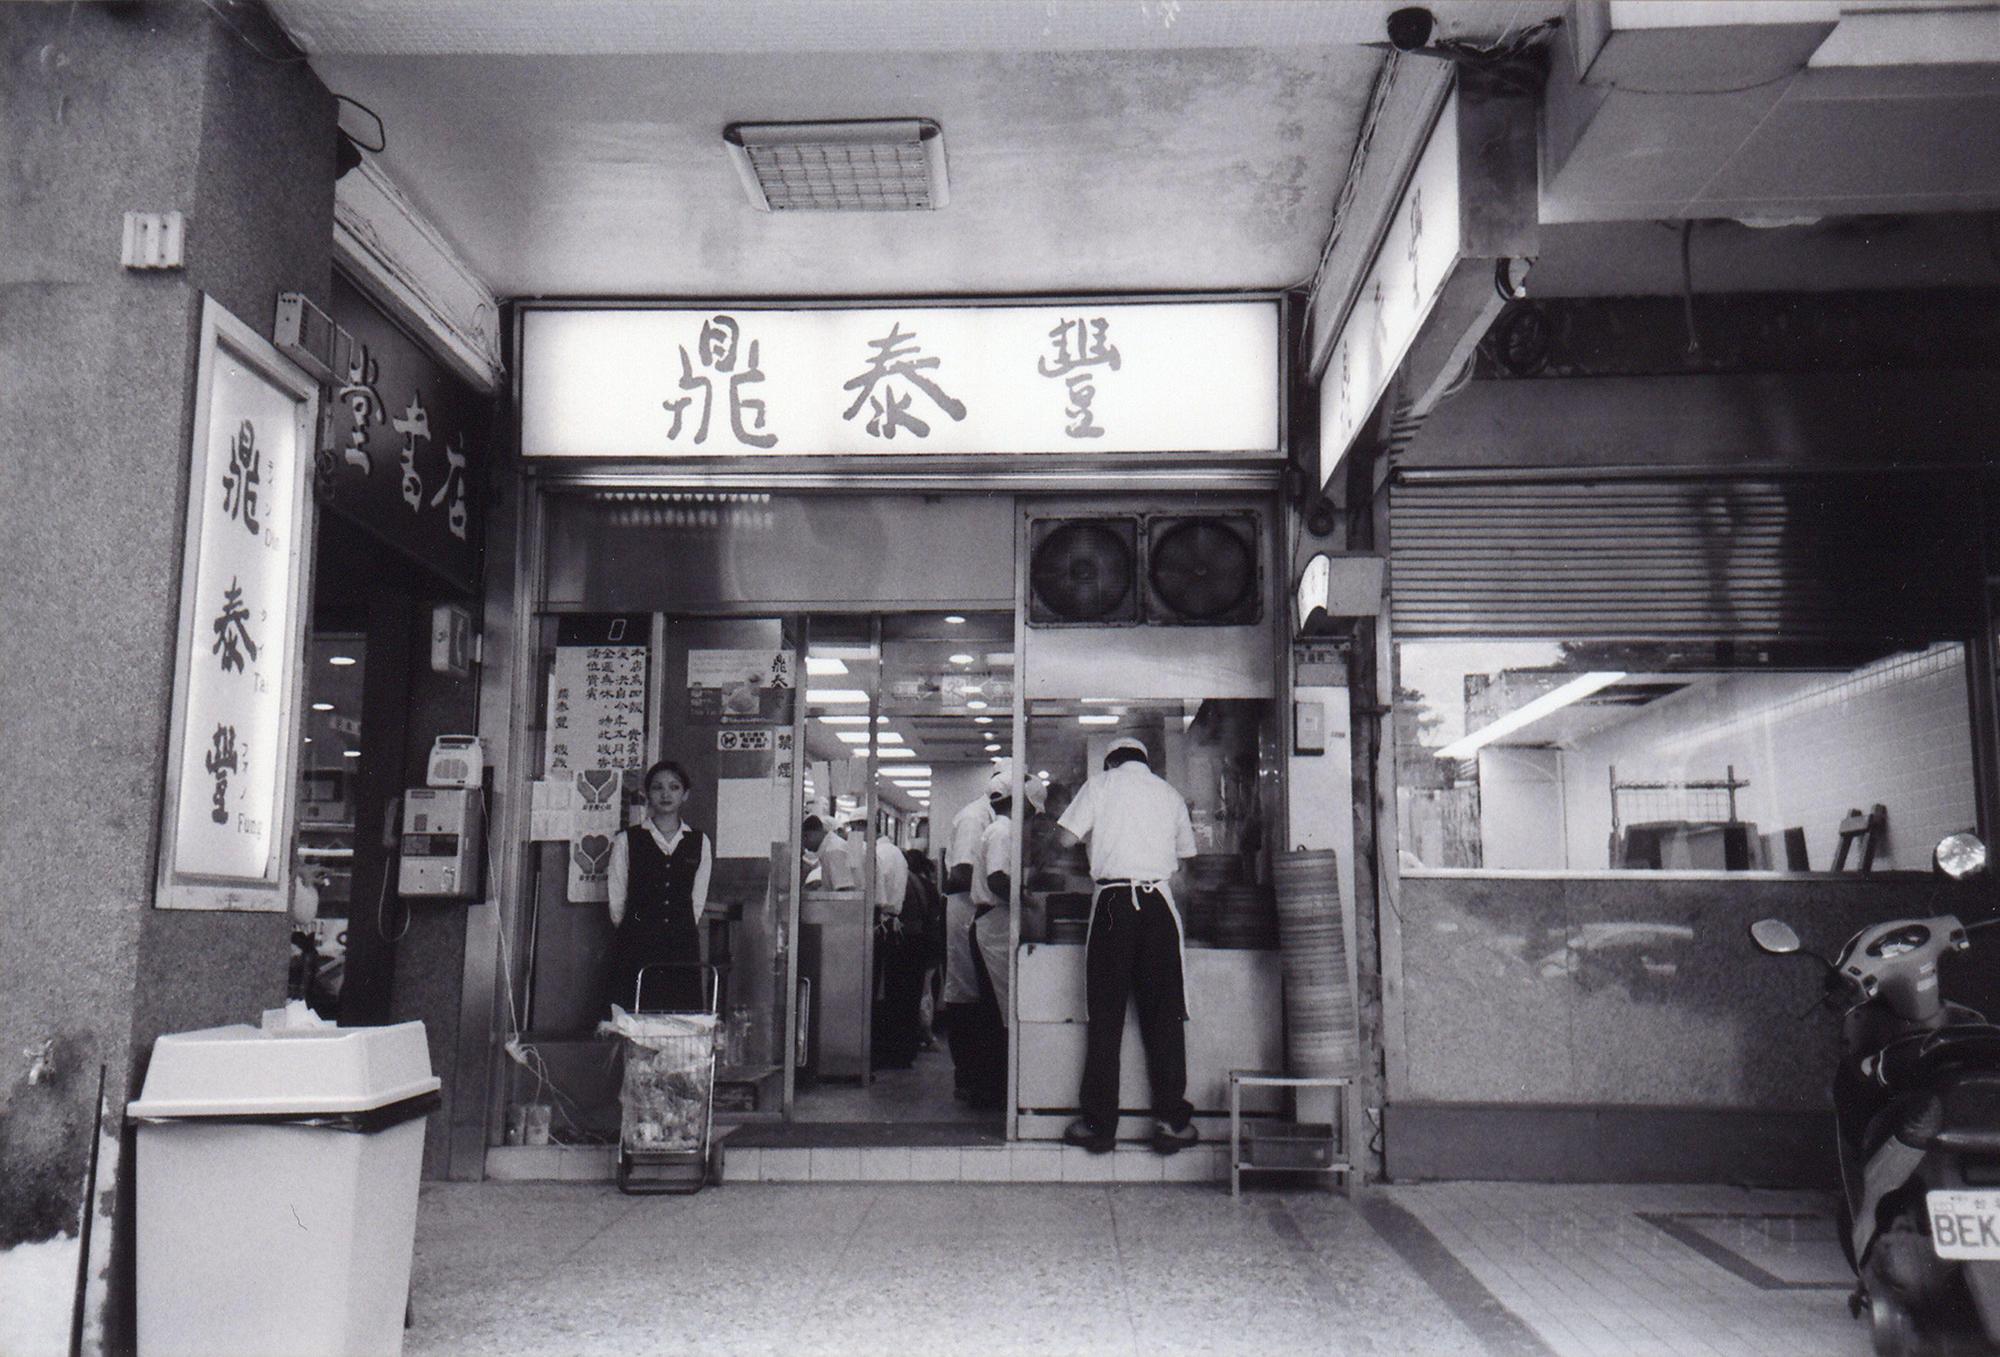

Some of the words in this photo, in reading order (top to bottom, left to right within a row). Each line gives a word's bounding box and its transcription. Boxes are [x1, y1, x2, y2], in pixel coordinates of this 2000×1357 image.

[662, 314, 1123, 449] 鼎泰豐
[206, 419, 260, 826] 鼎泰豐
[237, 812, 263, 840] Fung
